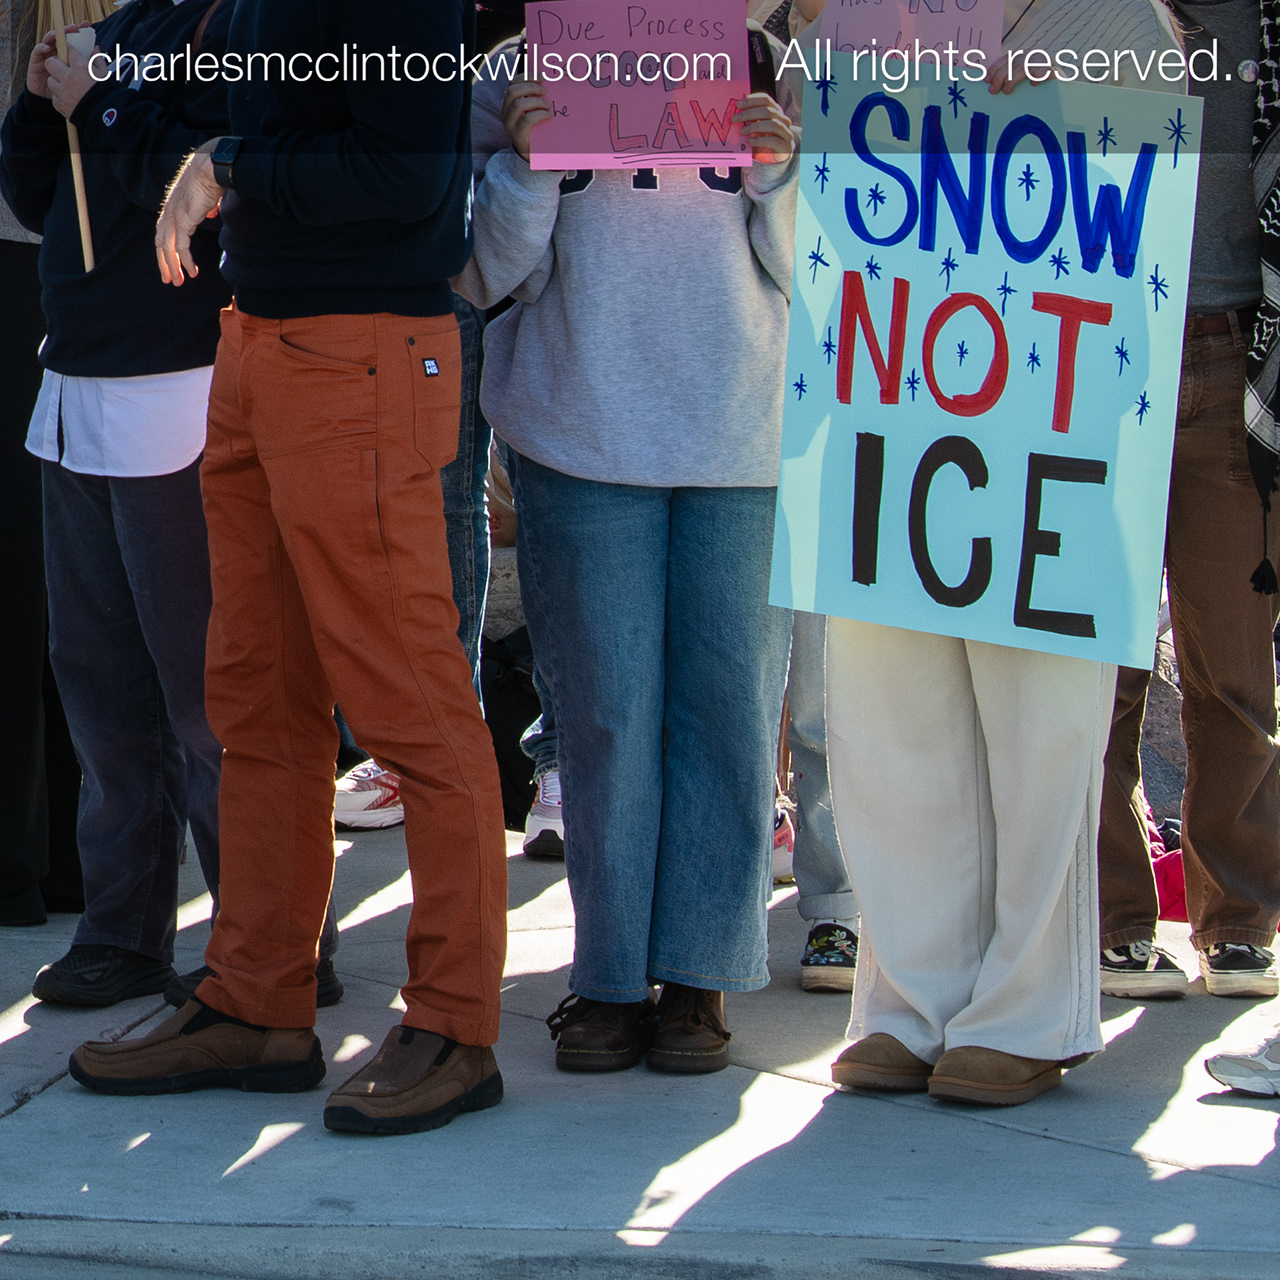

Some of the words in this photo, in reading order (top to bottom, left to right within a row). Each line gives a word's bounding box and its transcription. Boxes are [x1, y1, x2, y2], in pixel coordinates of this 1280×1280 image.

[538, 10, 604, 45] Due
[627, 6, 725, 40] Process
[552, 100, 570, 117] he
[844, 91, 1157, 279] SNOW
[836, 269, 1113, 433] NOT
[851, 431, 1110, 640] ICE
